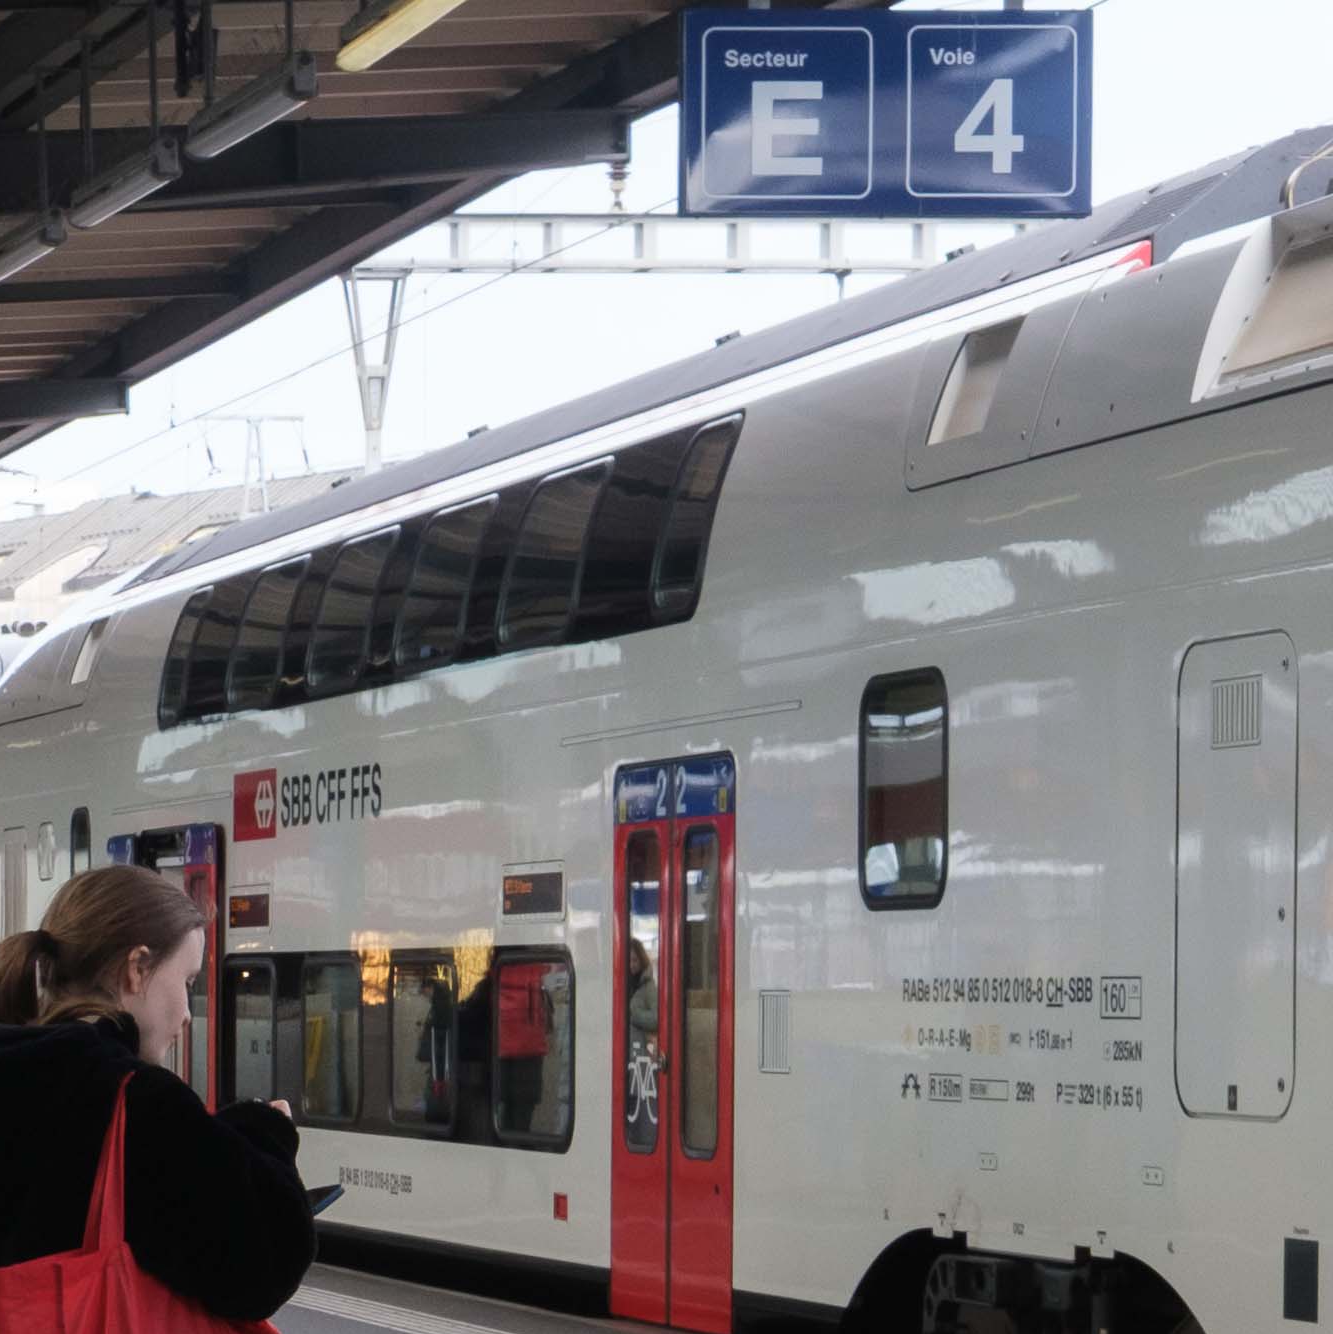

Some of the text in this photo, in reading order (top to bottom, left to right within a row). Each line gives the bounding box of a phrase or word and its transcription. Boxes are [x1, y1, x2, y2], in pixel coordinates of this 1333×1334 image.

[725, 50, 808, 68] Secteur
[930, 47, 975, 65] Voie
[752, 81, 823, 176] E
[954, 78, 1024, 173] 4
[281, 762, 382, 829] SBB CFF FFS
[656, 768, 667, 817] 2
[676, 765, 686, 814] 2
[903, 977, 1093, 1008] RABe 512 94 85 0 512 018-8 CH-SBB
[1103, 984, 1126, 1013] 160
[1078, 1084, 1094, 1104] 329
